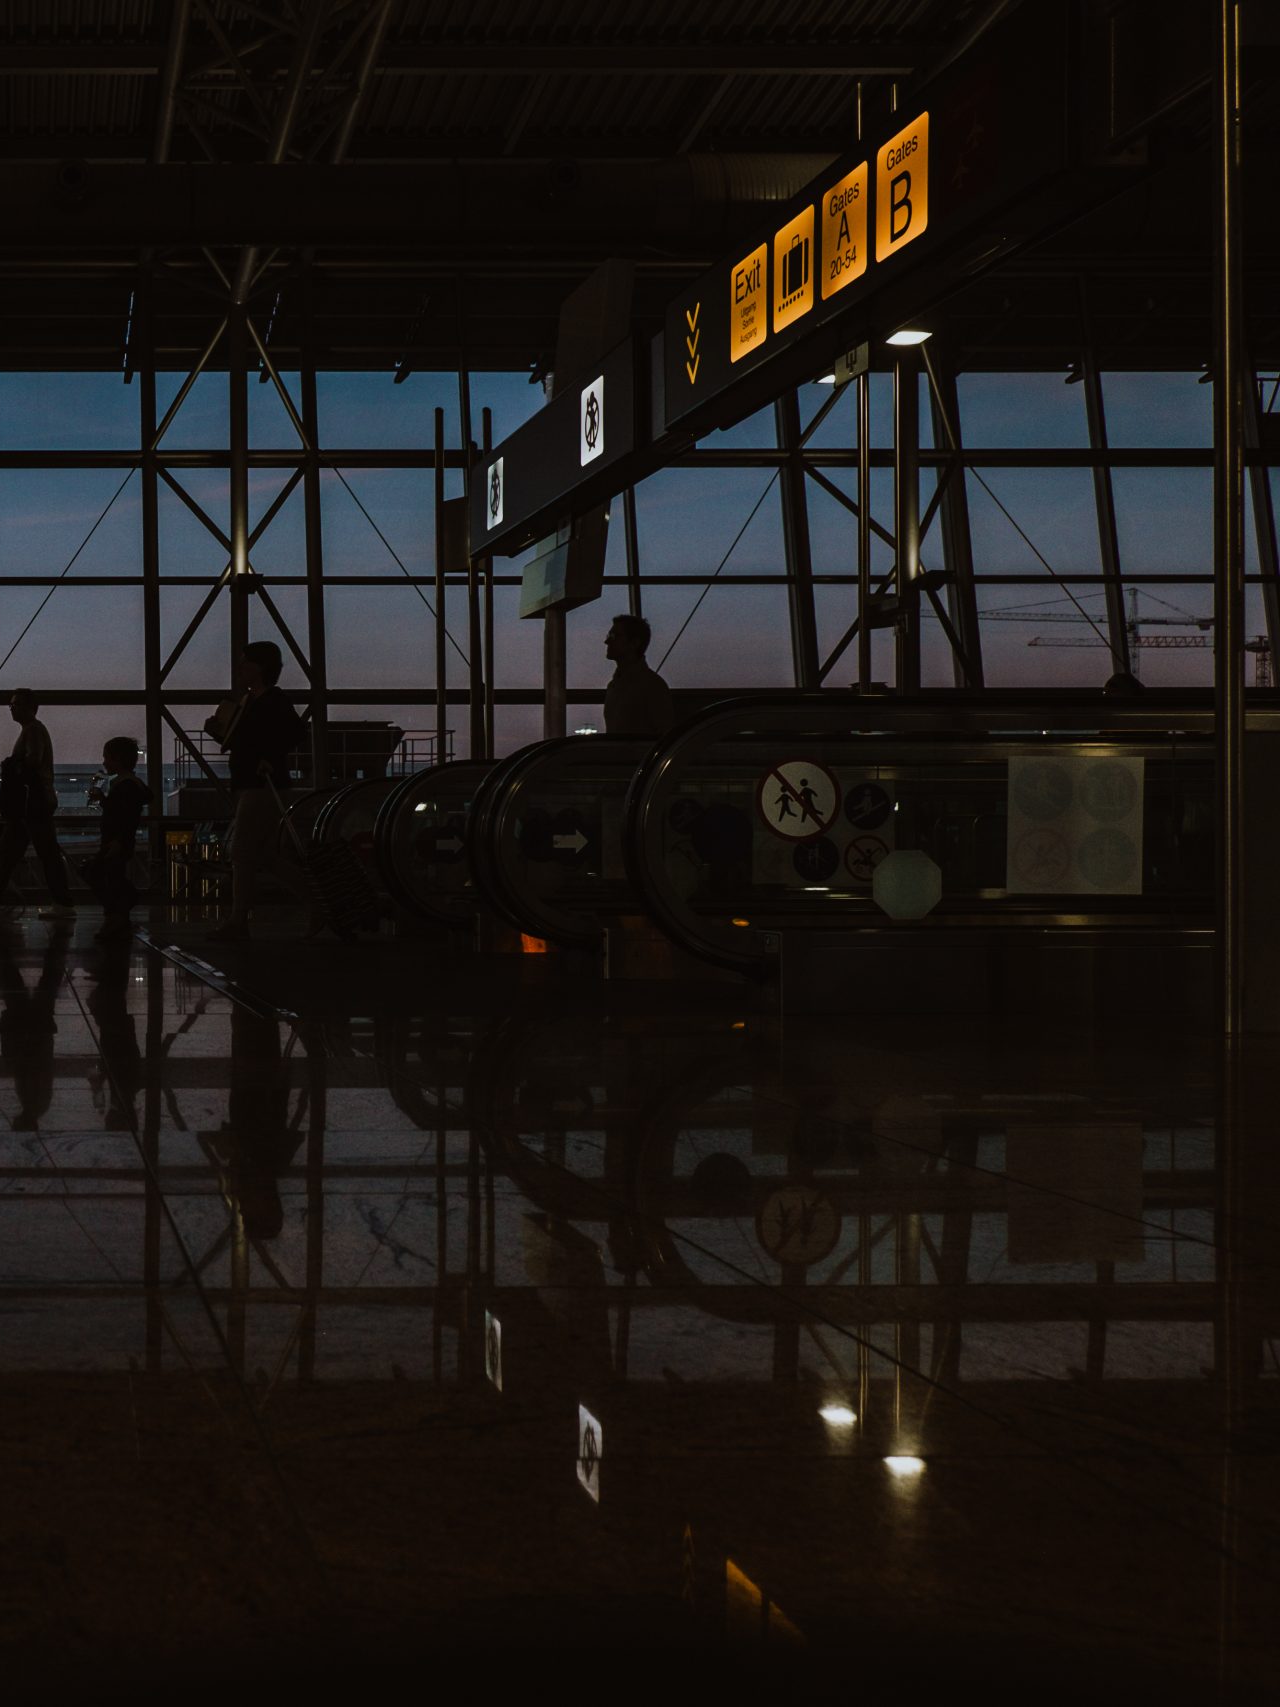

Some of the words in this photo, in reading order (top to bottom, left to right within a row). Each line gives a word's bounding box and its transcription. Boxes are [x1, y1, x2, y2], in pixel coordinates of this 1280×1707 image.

[887, 135, 918, 171] Gates
[829, 182, 860, 217] Gates
[890, 170, 912, 244] B
[837, 210, 851, 251] A
[735, 259, 761, 304] Exit
[830, 245, 857, 280] 20-54
